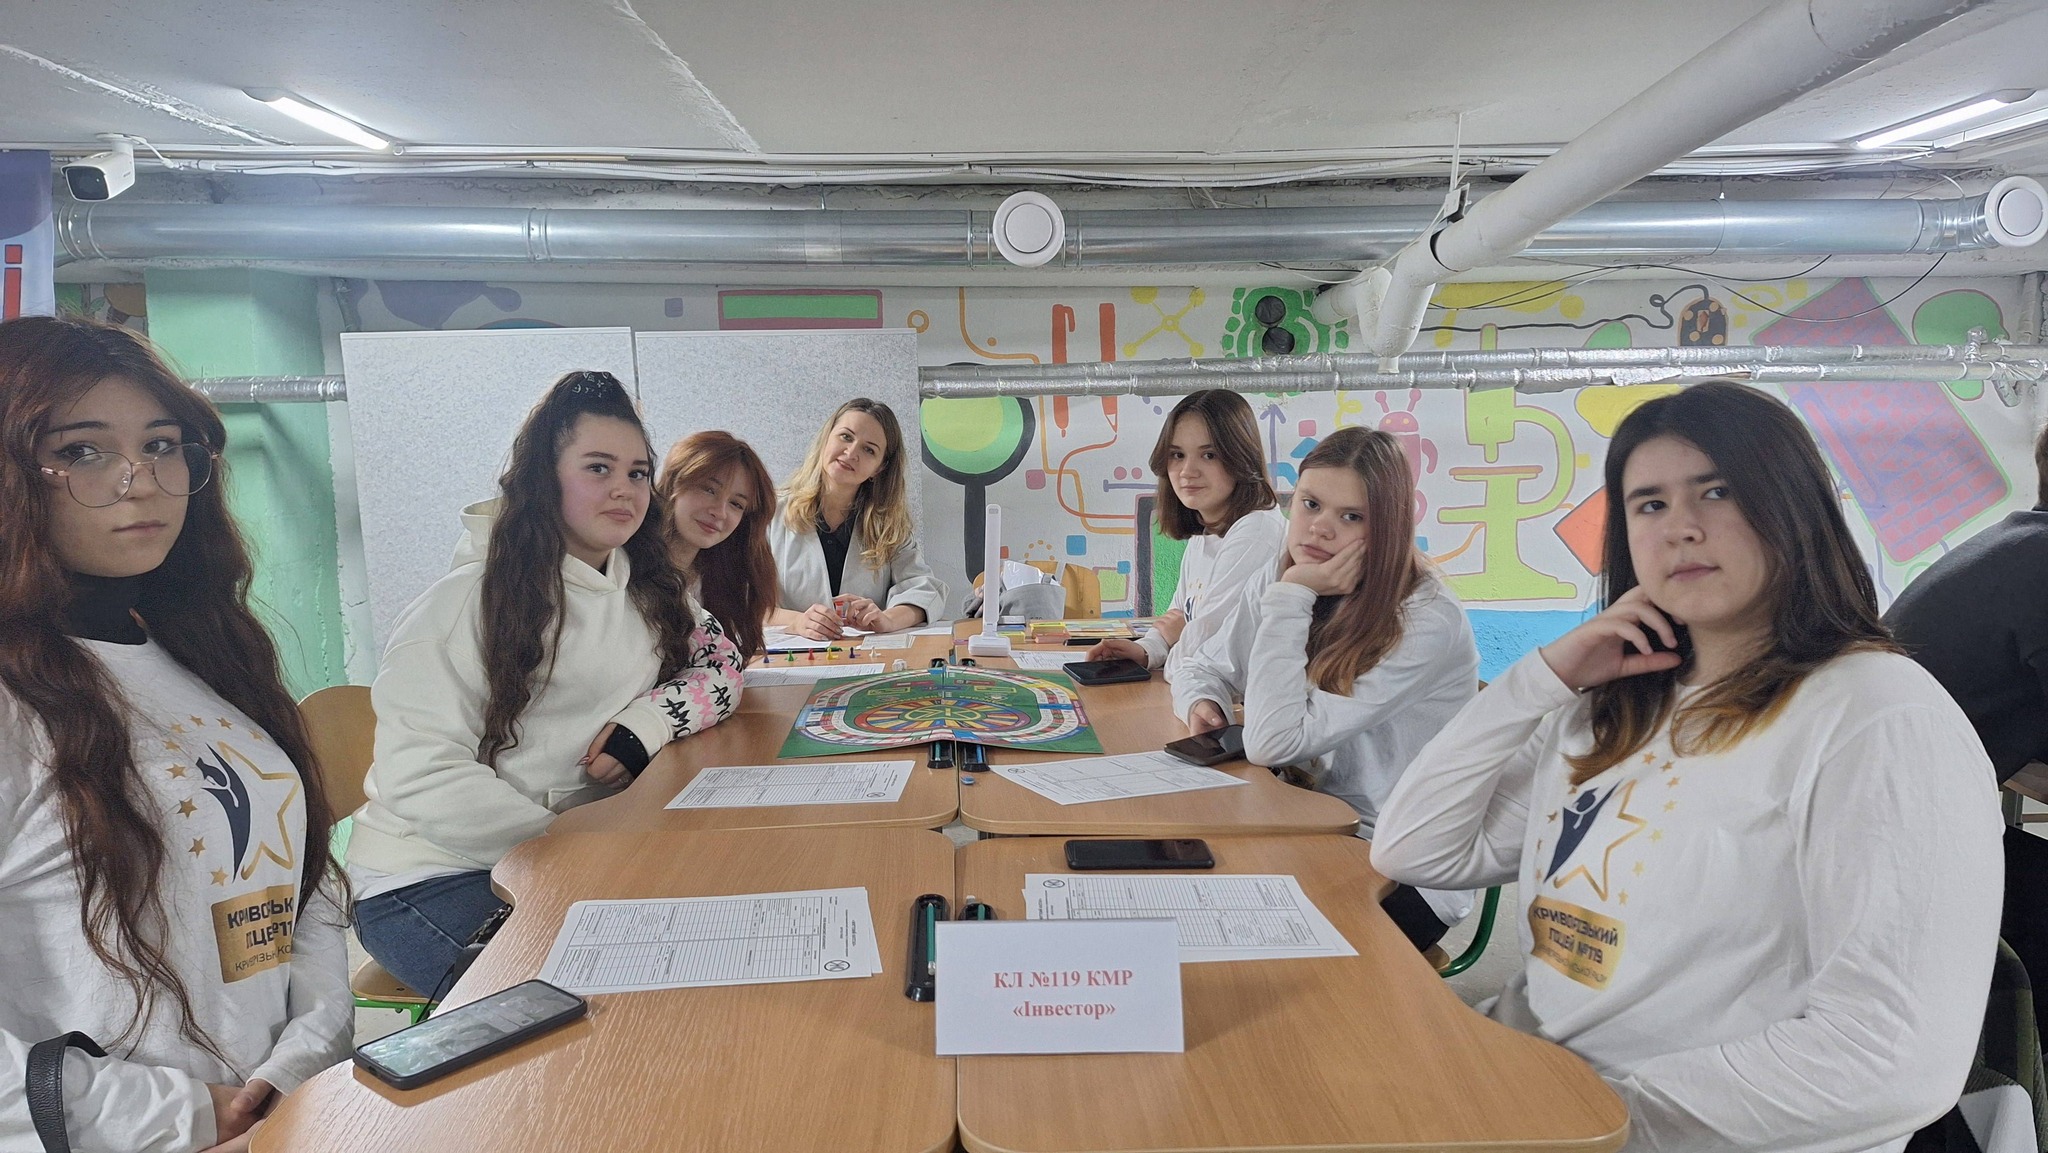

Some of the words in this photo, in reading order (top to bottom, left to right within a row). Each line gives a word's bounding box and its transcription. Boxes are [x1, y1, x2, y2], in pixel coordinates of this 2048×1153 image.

[994, 972, 1023, 988] КЛ
[1029, 970, 1081, 988] №119
[1087, 969, 1133, 986] КМР
[1013, 1001, 1116, 1020] «Інвестор»
